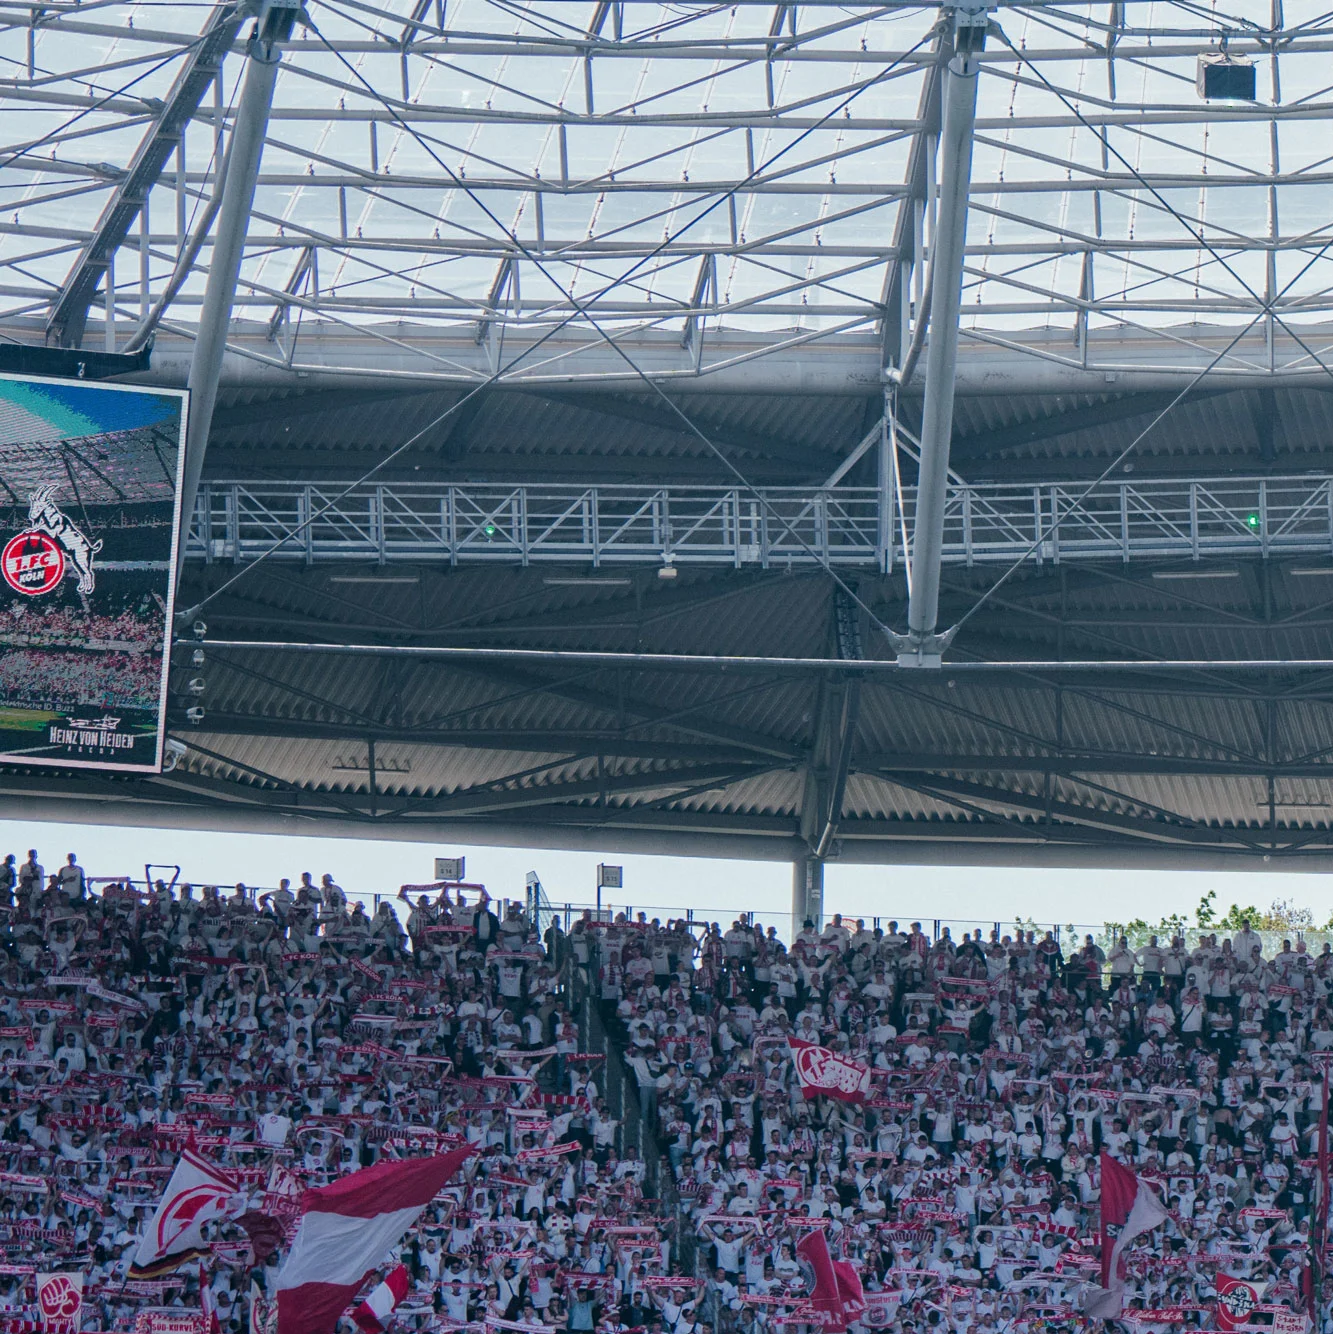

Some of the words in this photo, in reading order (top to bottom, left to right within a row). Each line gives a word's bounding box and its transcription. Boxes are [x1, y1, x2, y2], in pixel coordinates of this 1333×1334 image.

[15, 552, 50, 572] 1.FC
[19, 571, 45, 583] KÖLN
[50, 726, 77, 745] HEINZ
[79, 730, 98, 747] VON
[99, 731, 134, 749] HEIDEN
